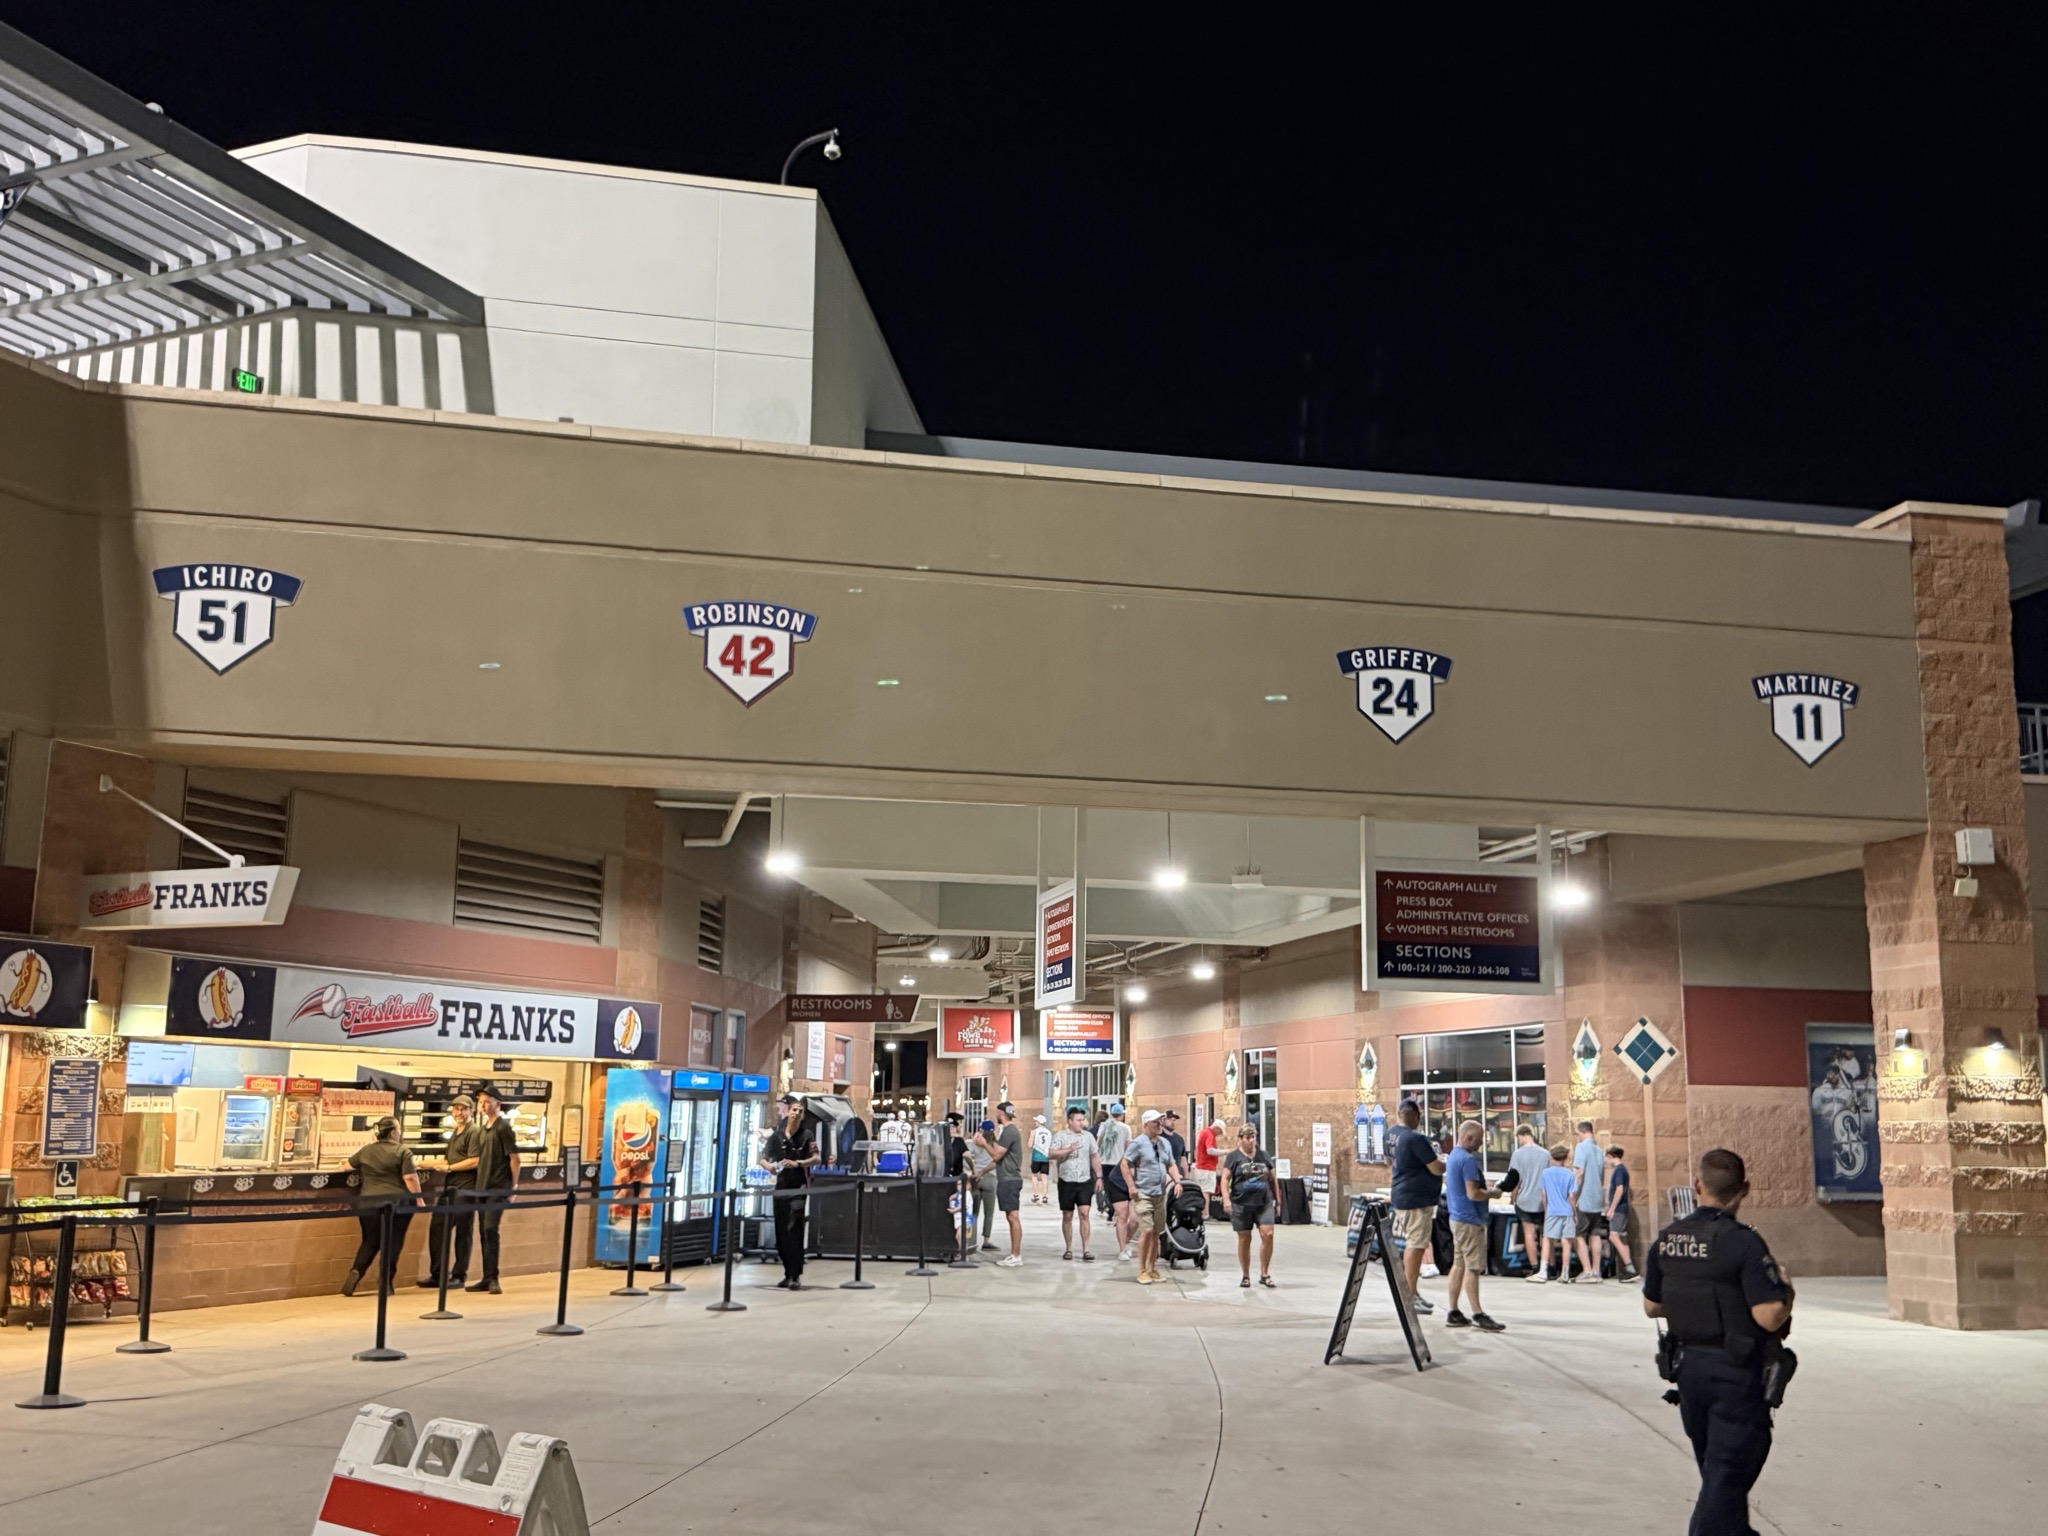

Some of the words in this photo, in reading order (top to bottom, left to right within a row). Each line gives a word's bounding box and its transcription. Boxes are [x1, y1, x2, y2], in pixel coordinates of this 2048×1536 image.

[239, 371, 257, 392] EXIT
[182, 566, 273, 592] ICHIRO
[197, 599, 247, 645] 51
[692, 603, 806, 633] ROBINSON
[719, 634, 774, 678] 42
[1350, 648, 1438, 673] GRIFFEY
[1372, 676, 1419, 717] 24
[1756, 674, 1855, 701] MARTINEZ
[1792, 703, 1823, 741] 11
[153, 880, 268, 910] FRANKS
[1396, 879, 1464, 892] AUTOGRAPH
[1465, 882, 1498, 893] ALLEY
[1396, 896, 1427, 906] PRESS
[1429, 897, 1453, 907] BOX
[1396, 909, 1484, 922] ADMINISTRATIVE
[1486, 912, 1530, 924] OFFICES
[1396, 924, 1449, 936] WOMEN'S
[1451, 926, 1515, 938] RESTROOMS
[1396, 944, 1472, 959] SECTIONS
[1046, 963, 1063, 978] SECTIONS
[1397, 963, 1431, 972] 100-124
[1437, 964, 1471, 974] 200-220
[1477, 966, 1510, 976] 304-308
[791, 998, 873, 1010] RESTROOMS
[342, 992, 439, 1036] Fastball
[437, 999, 576, 1044] FRANKS
[620, 1150, 650, 1162] pepsi
[1667, 1233, 1696, 1243] PEORIA
[1659, 1241, 1708, 1258] POLICE
